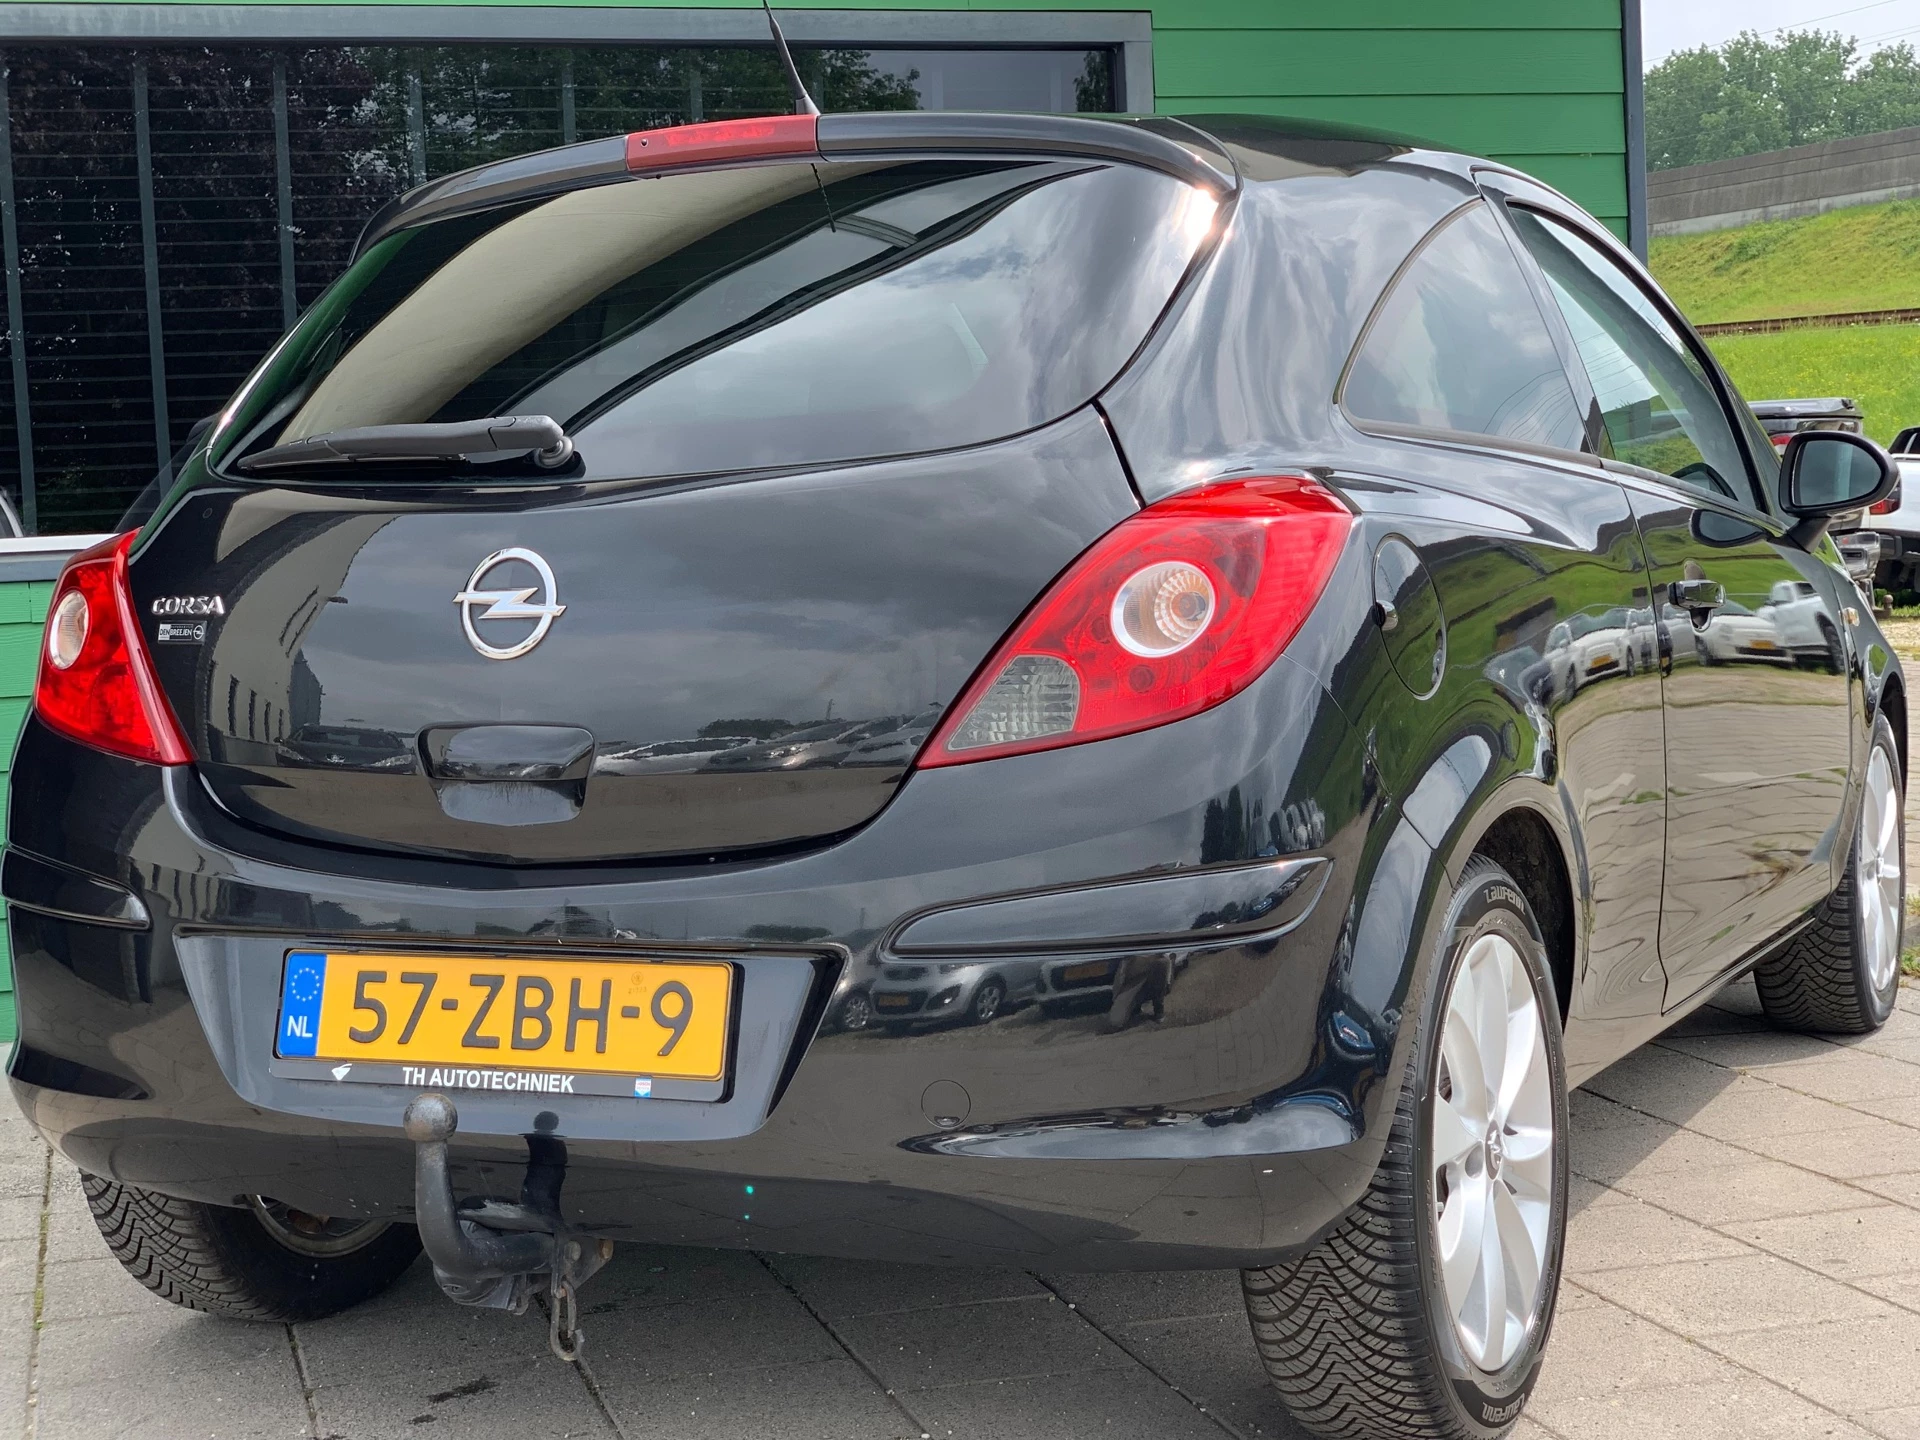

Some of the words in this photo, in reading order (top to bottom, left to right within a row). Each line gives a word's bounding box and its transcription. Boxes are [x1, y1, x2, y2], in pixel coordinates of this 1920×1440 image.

[152, 595, 225, 615] CORSA
[349, 971, 693, 1056] 57-ZBH-9
[287, 1015, 313, 1037] NL
[402, 1067, 425, 1085] TH
[428, 1068, 575, 1093] AUTOTECHNIEK
